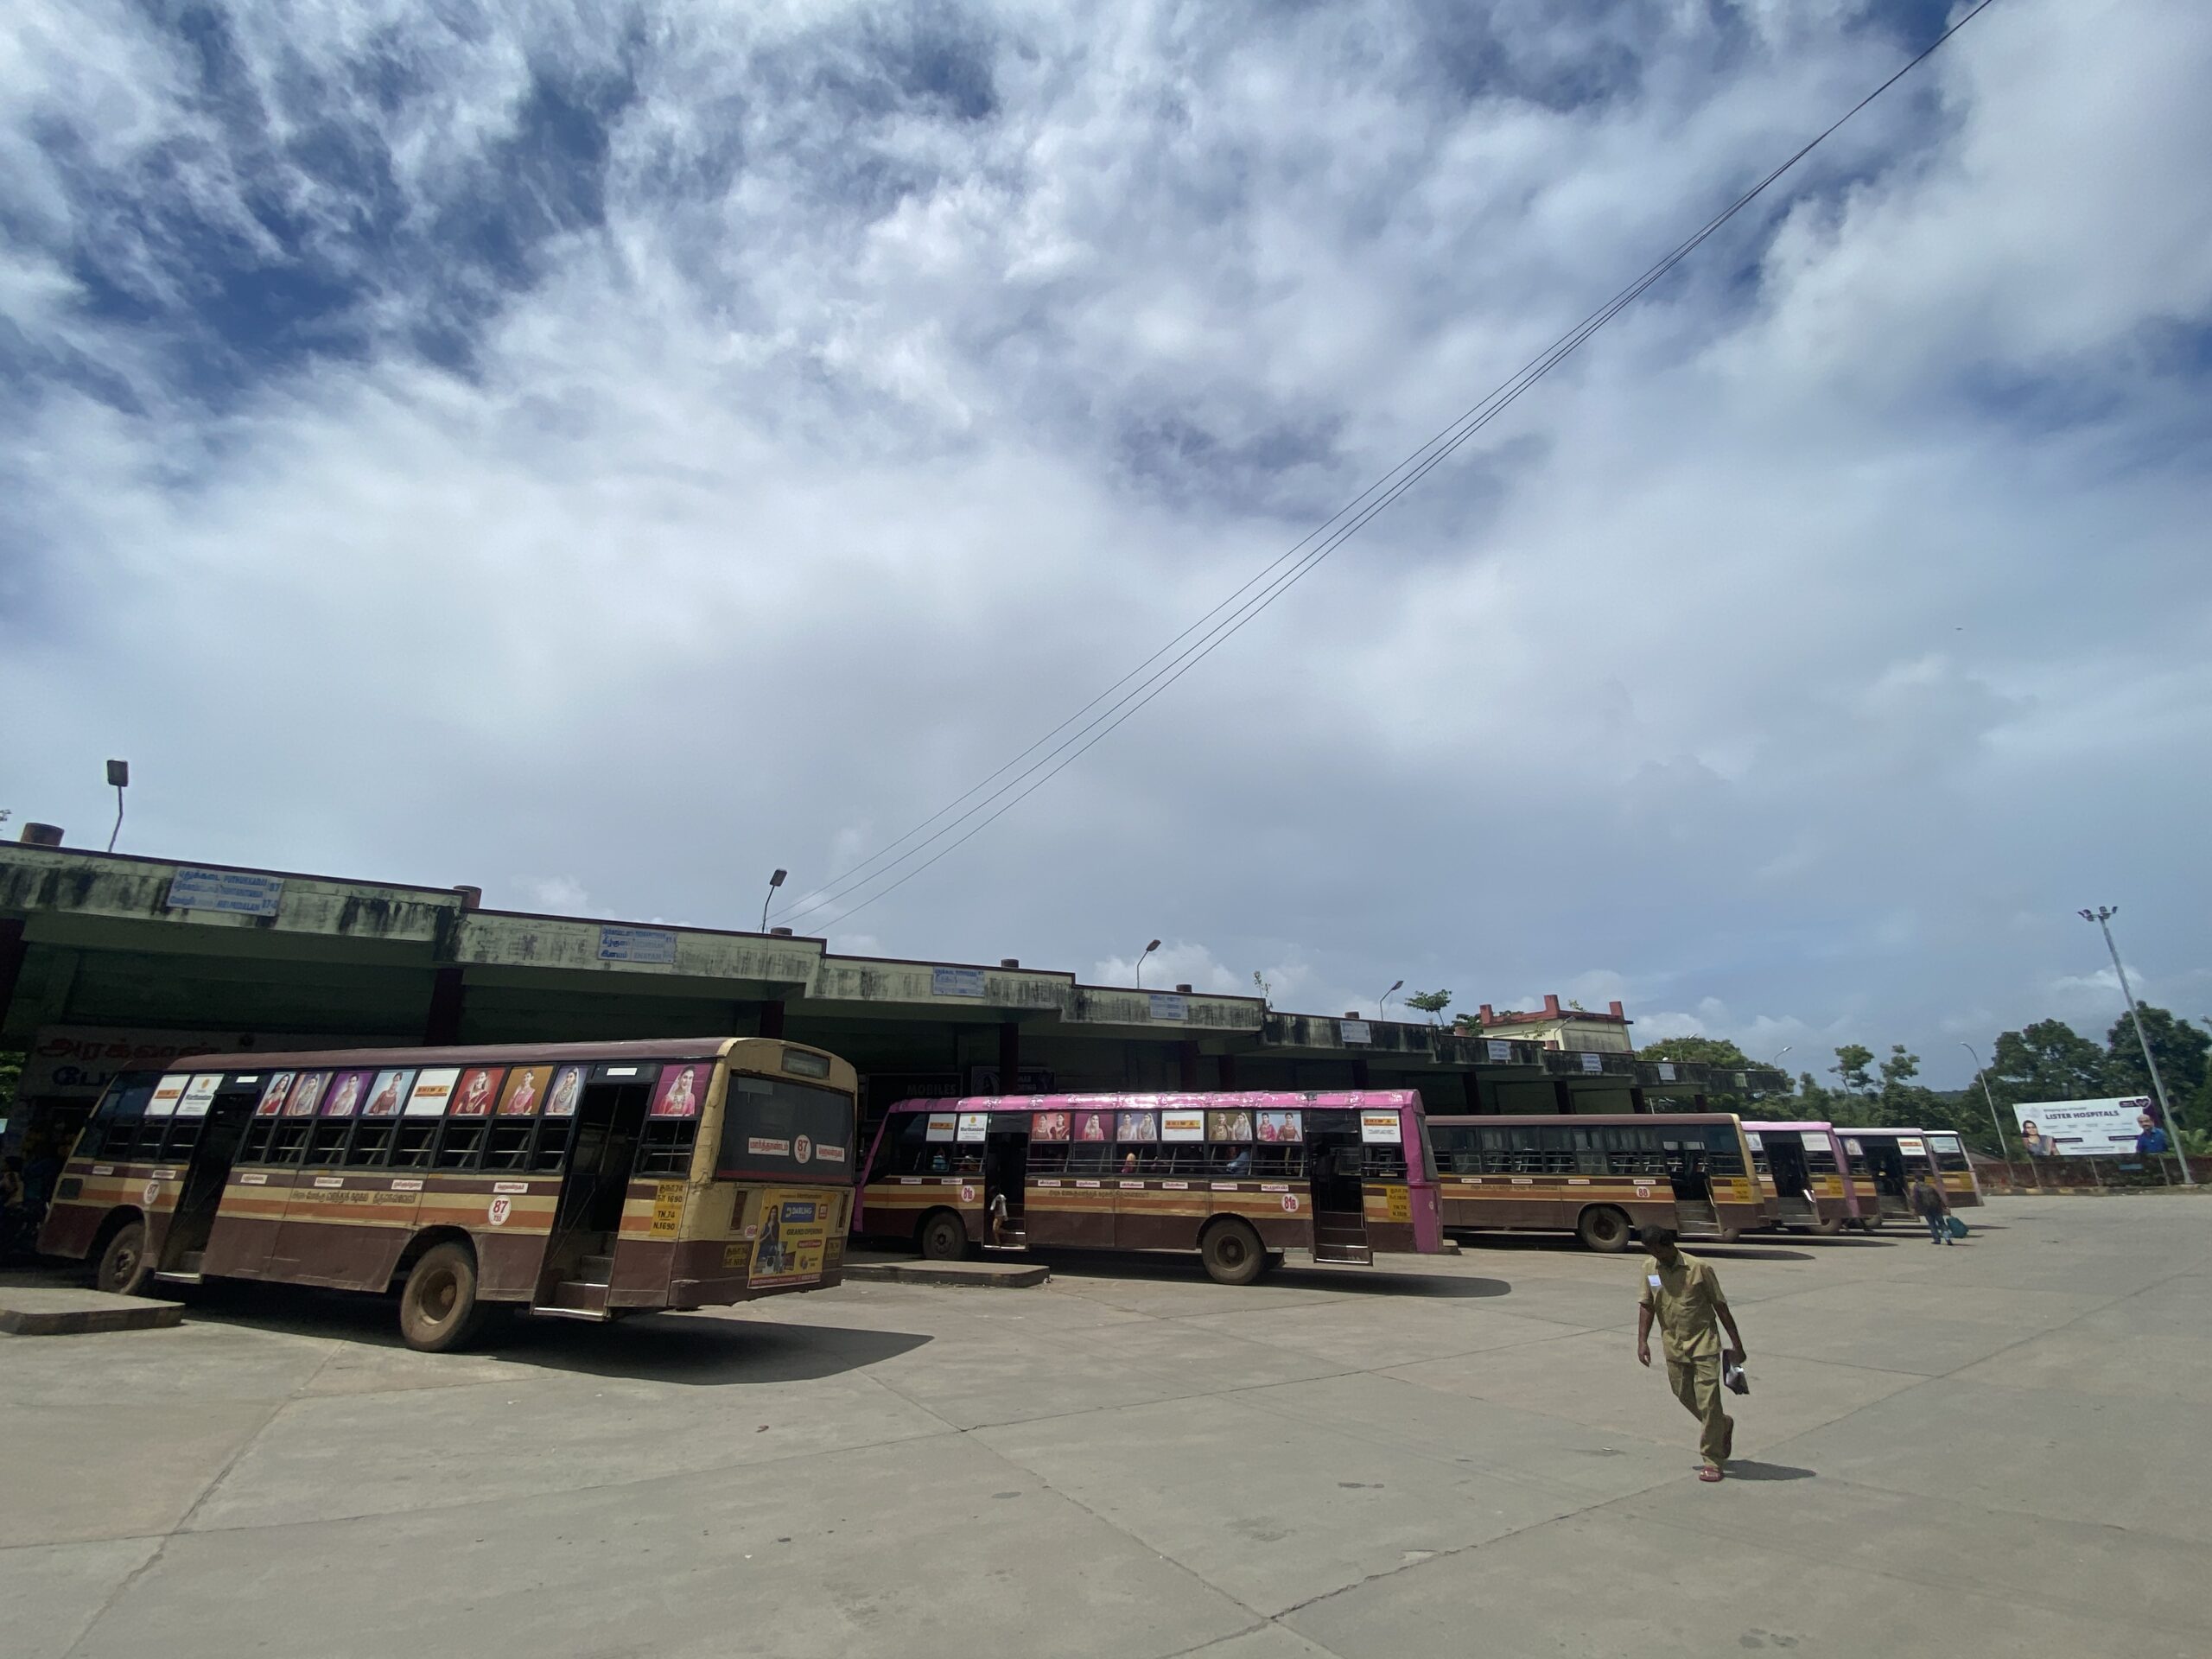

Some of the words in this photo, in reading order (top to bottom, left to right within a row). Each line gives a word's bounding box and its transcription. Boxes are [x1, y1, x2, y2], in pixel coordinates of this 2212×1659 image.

[906, 1084, 957, 1096] MOBILES
[2074, 1110, 2120, 1119] HOSPITALS
[798, 1139, 809, 1152] 87
[147, 1184, 157, 1194] 87
[1638, 1188, 1648, 1197] 88
[493, 1200, 509, 1214] 87
[1285, 1196, 1296, 1210] 81B
[792, 1206, 812, 1215] DARLING
